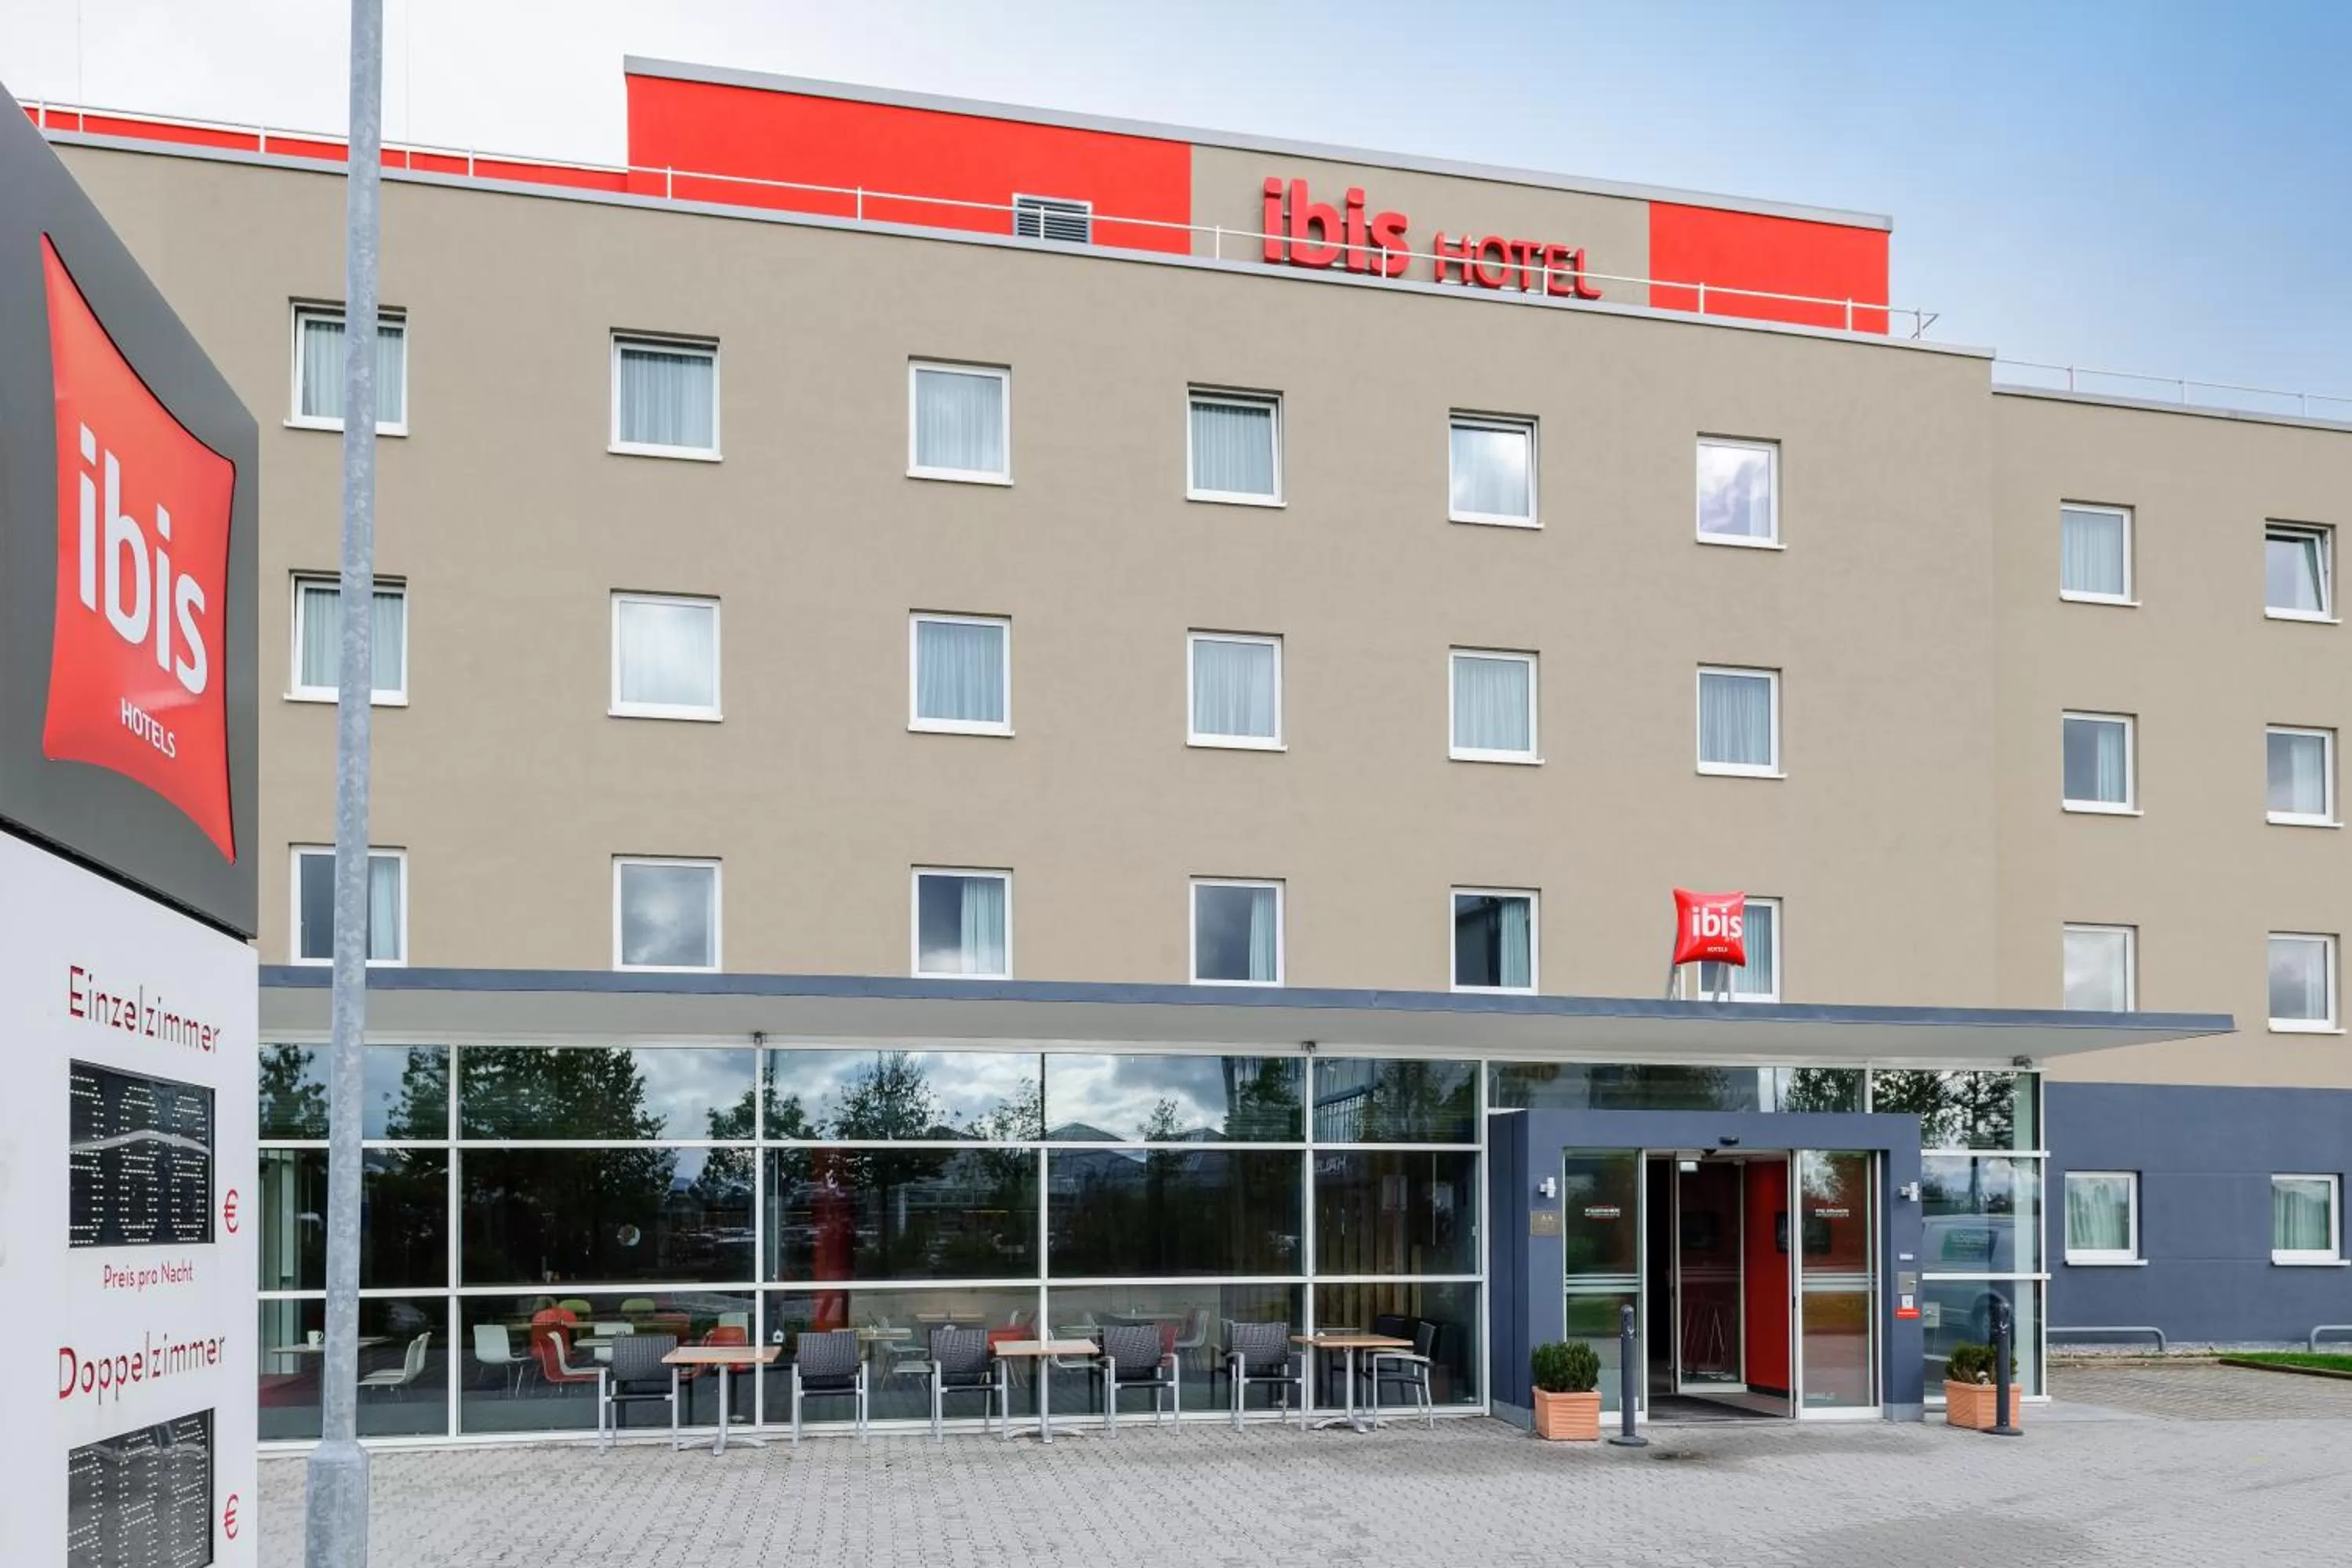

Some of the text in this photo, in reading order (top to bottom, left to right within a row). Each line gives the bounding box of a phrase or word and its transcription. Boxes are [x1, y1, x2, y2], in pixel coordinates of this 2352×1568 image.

[1263, 176, 1602, 299] ibis HOTEL
[79, 421, 207, 695] ibis
[121, 697, 176, 758] HOTELS
[1692, 906, 1743, 938] ibis
[70, 965, 220, 1054] Einzelzimmer
[223, 1189, 239, 1232] €
[103, 1258, 194, 1292] Preis pro Nacht
[59, 1330, 225, 1405] Doppelzimmer
[223, 1494, 239, 1540] €
